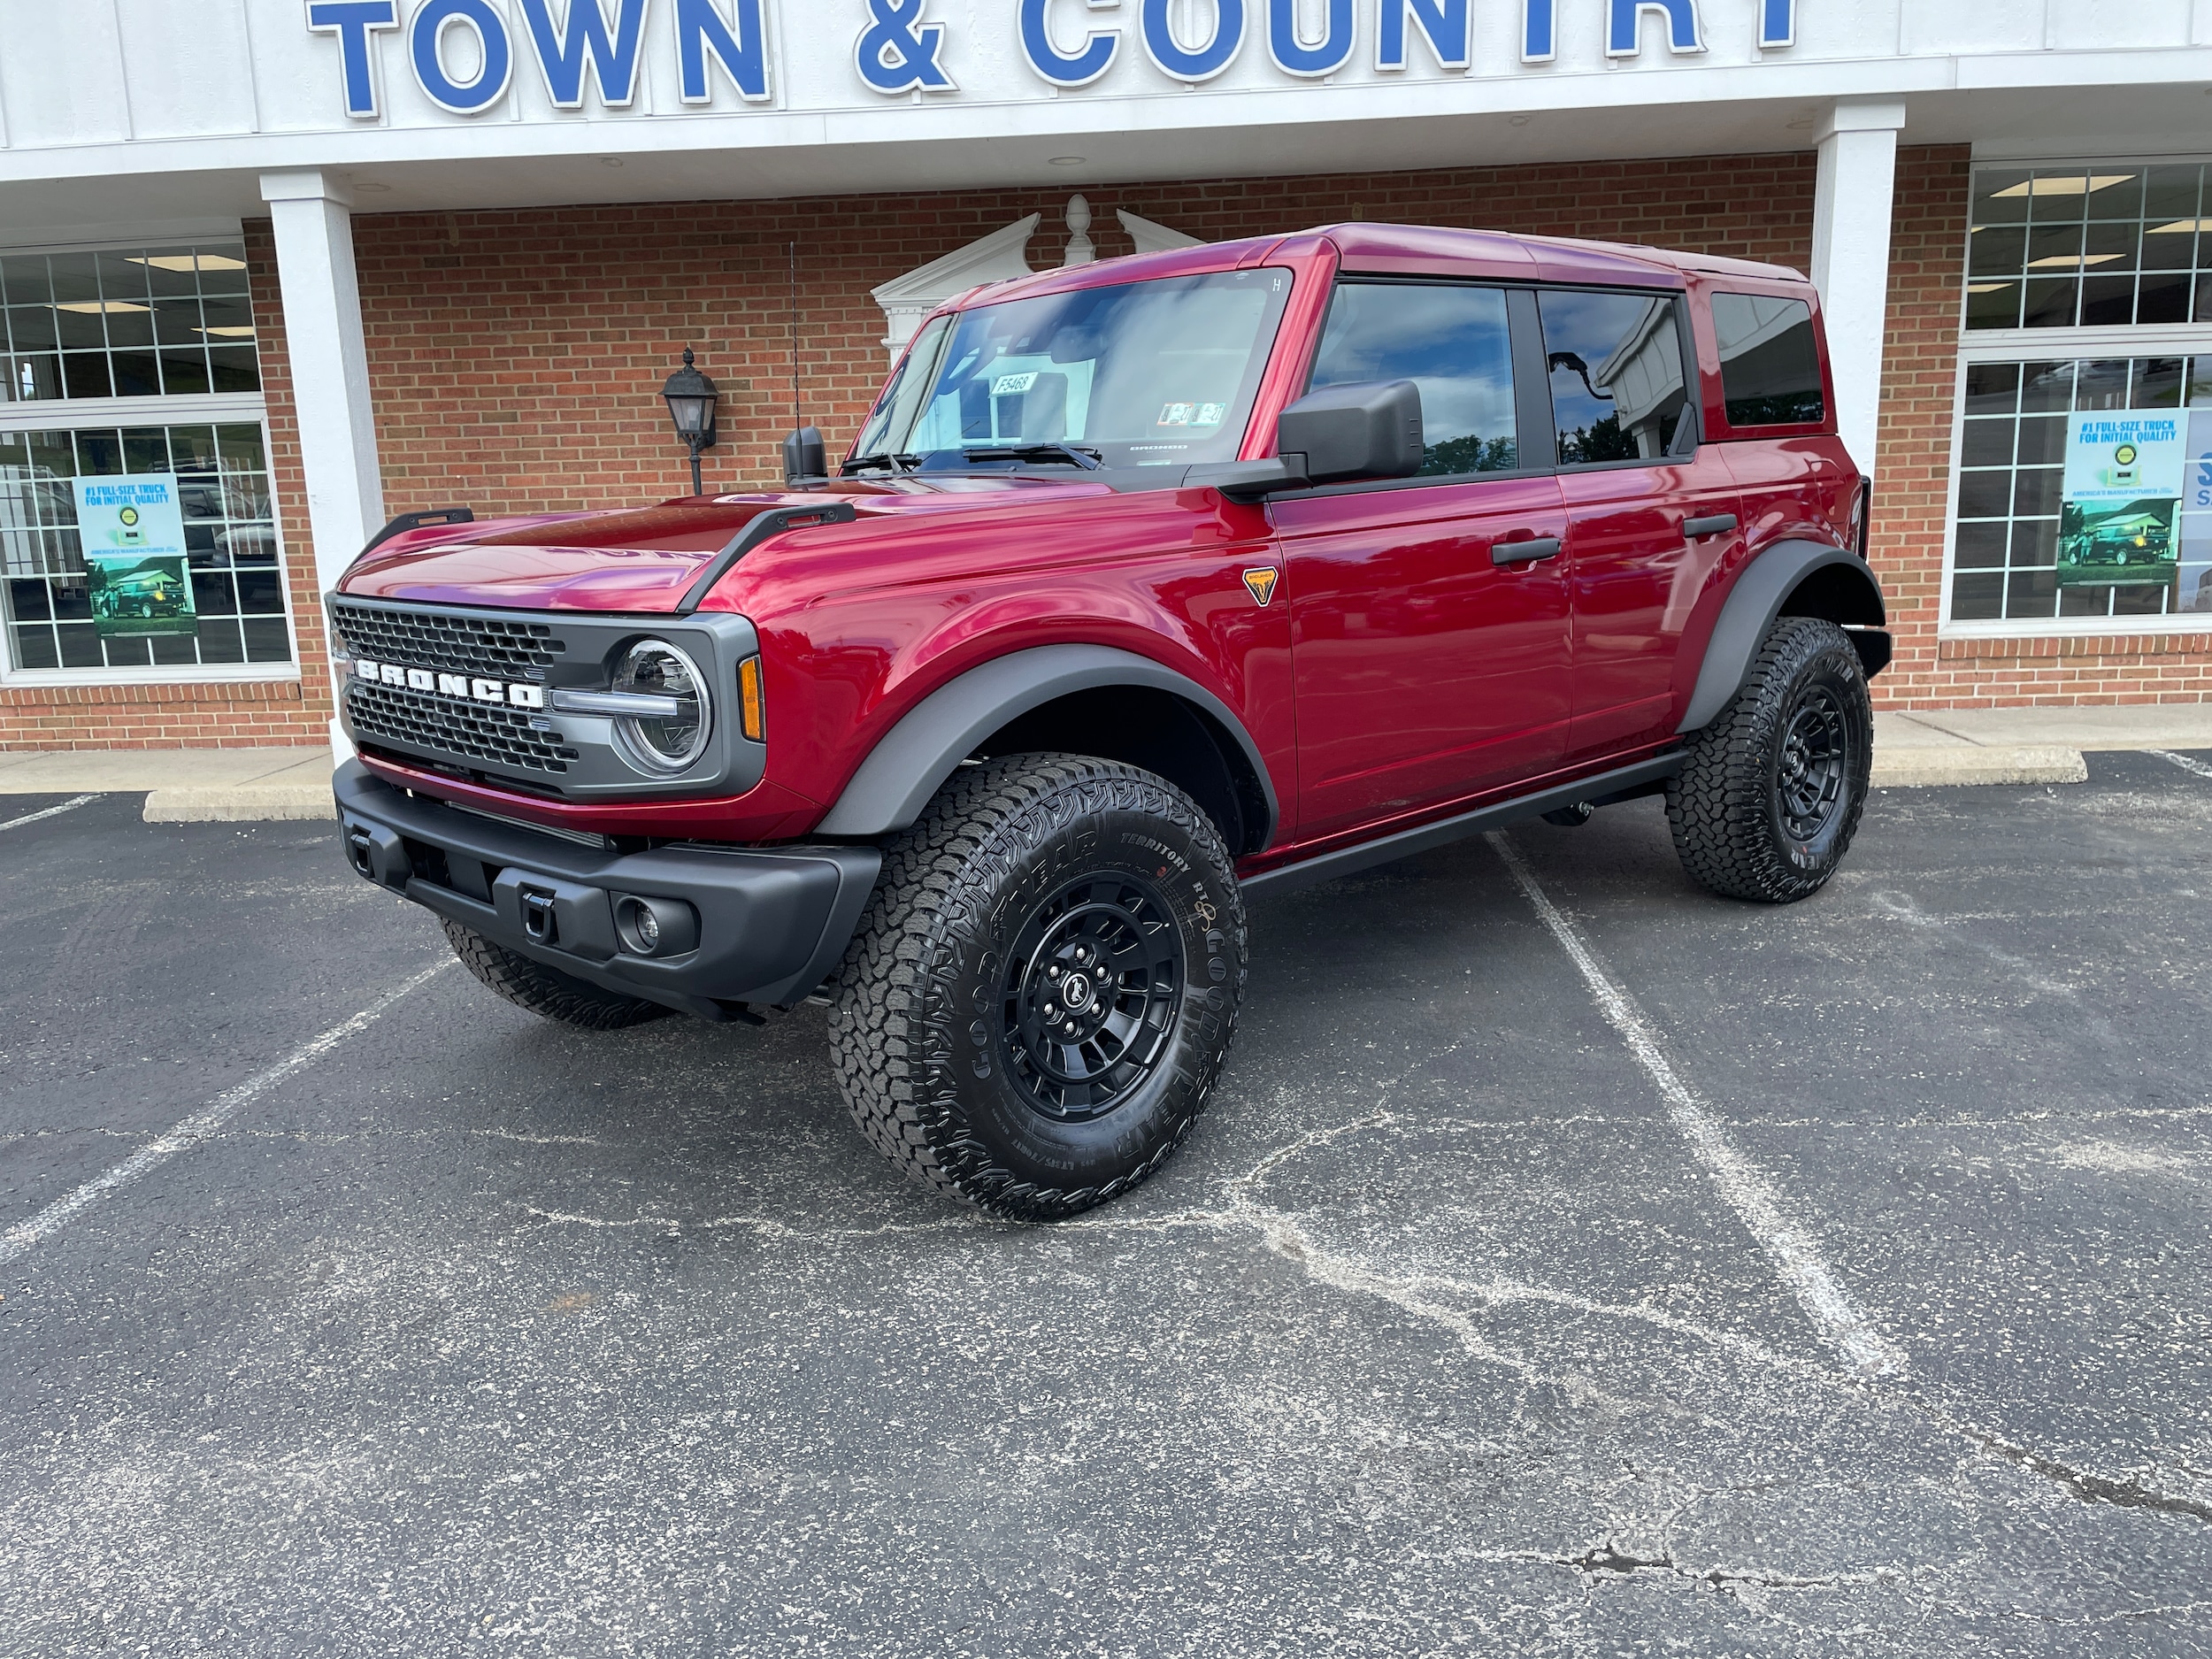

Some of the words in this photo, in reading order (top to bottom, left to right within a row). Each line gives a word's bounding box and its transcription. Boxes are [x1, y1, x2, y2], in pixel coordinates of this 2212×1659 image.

[305, 0, 772, 119] TOWN
[853, 0, 961, 96] &
[997, 376, 1029, 392] F5468
[2081, 421, 2093, 433] #1
[2096, 420, 2141, 433] FULL-SIZE
[2144, 419, 2174, 431] TRUCK
[2079, 433, 2099, 444] FOR
[2101, 432, 2134, 442] INITIAL
[2137, 430, 2176, 443] QUALITY
[86, 487, 95, 496] #1
[96, 485, 136, 495] FULL-SIZE
[138, 484, 166, 494] TRUCK
[86, 496, 103, 506] FOR
[104, 495, 134, 505] INITIAL
[134, 494, 168, 506] QUALITY
[357, 659, 543, 708] BRONCO
[1120, 832, 1192, 873] TERRITORY
